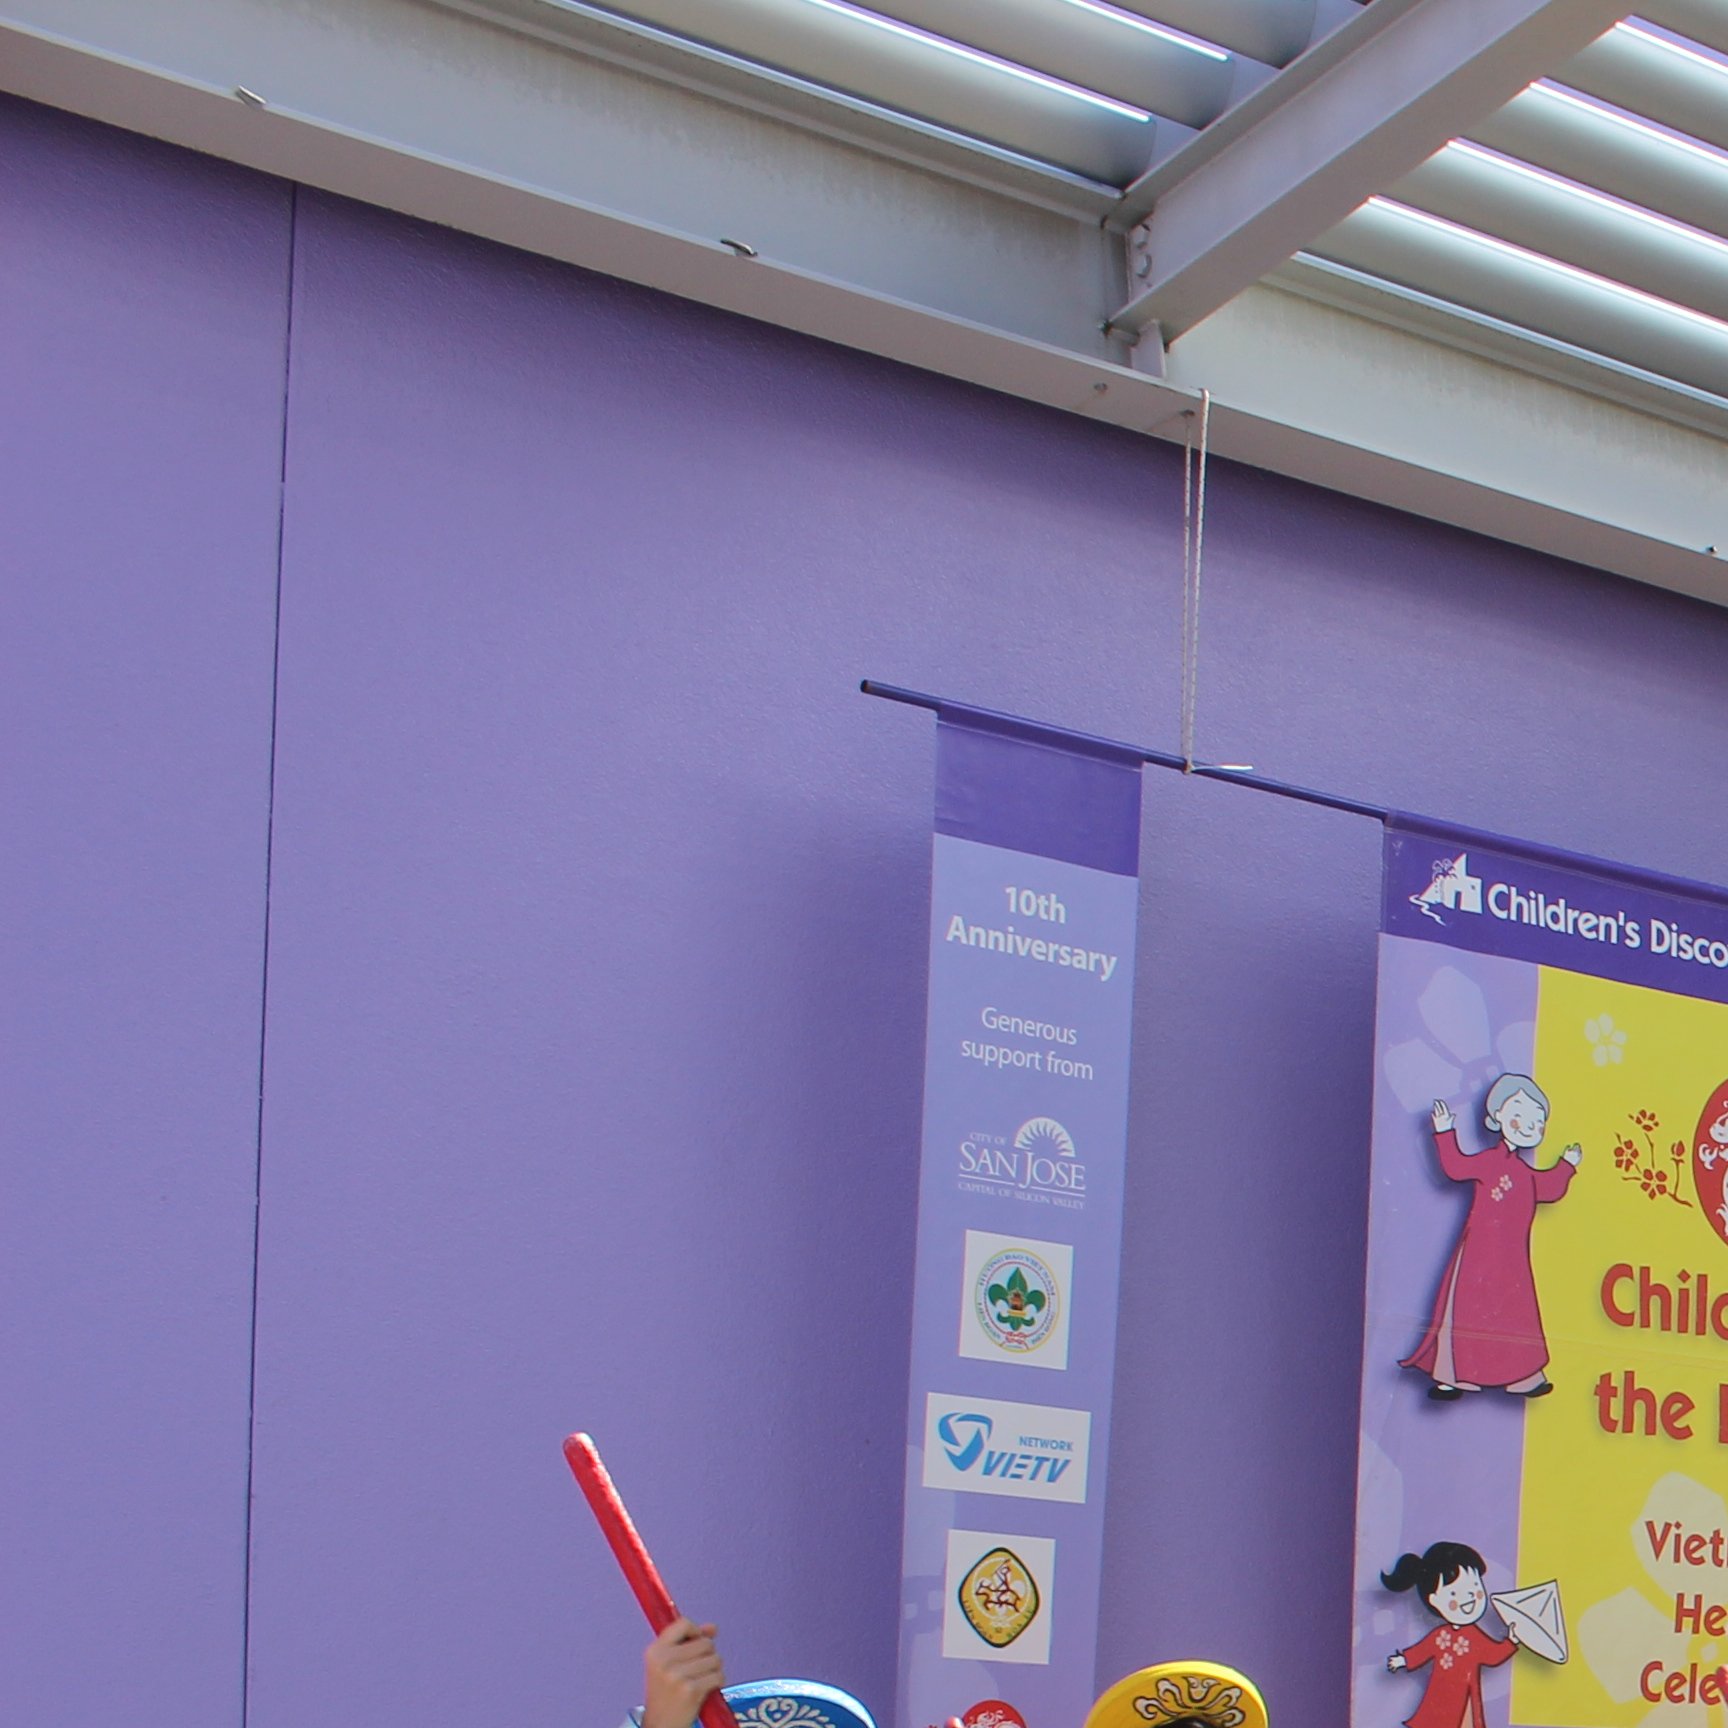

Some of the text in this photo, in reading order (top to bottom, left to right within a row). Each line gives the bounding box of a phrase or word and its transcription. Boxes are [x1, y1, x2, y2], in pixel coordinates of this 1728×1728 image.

[1004, 885, 1066, 924] 10th
[1488, 882, 1641, 949] Children's
[945, 915, 1117, 982] Anniversary
[982, 1007, 1077, 1046] Generous
[961, 1037, 1093, 1080] support from
[960, 1142, 1086, 1190] SAN JOSE
[1594, 1370, 1695, 1440] the
[1019, 1435, 1073, 1451] NETWORK
[981, 1450, 1071, 1483] VIETV
